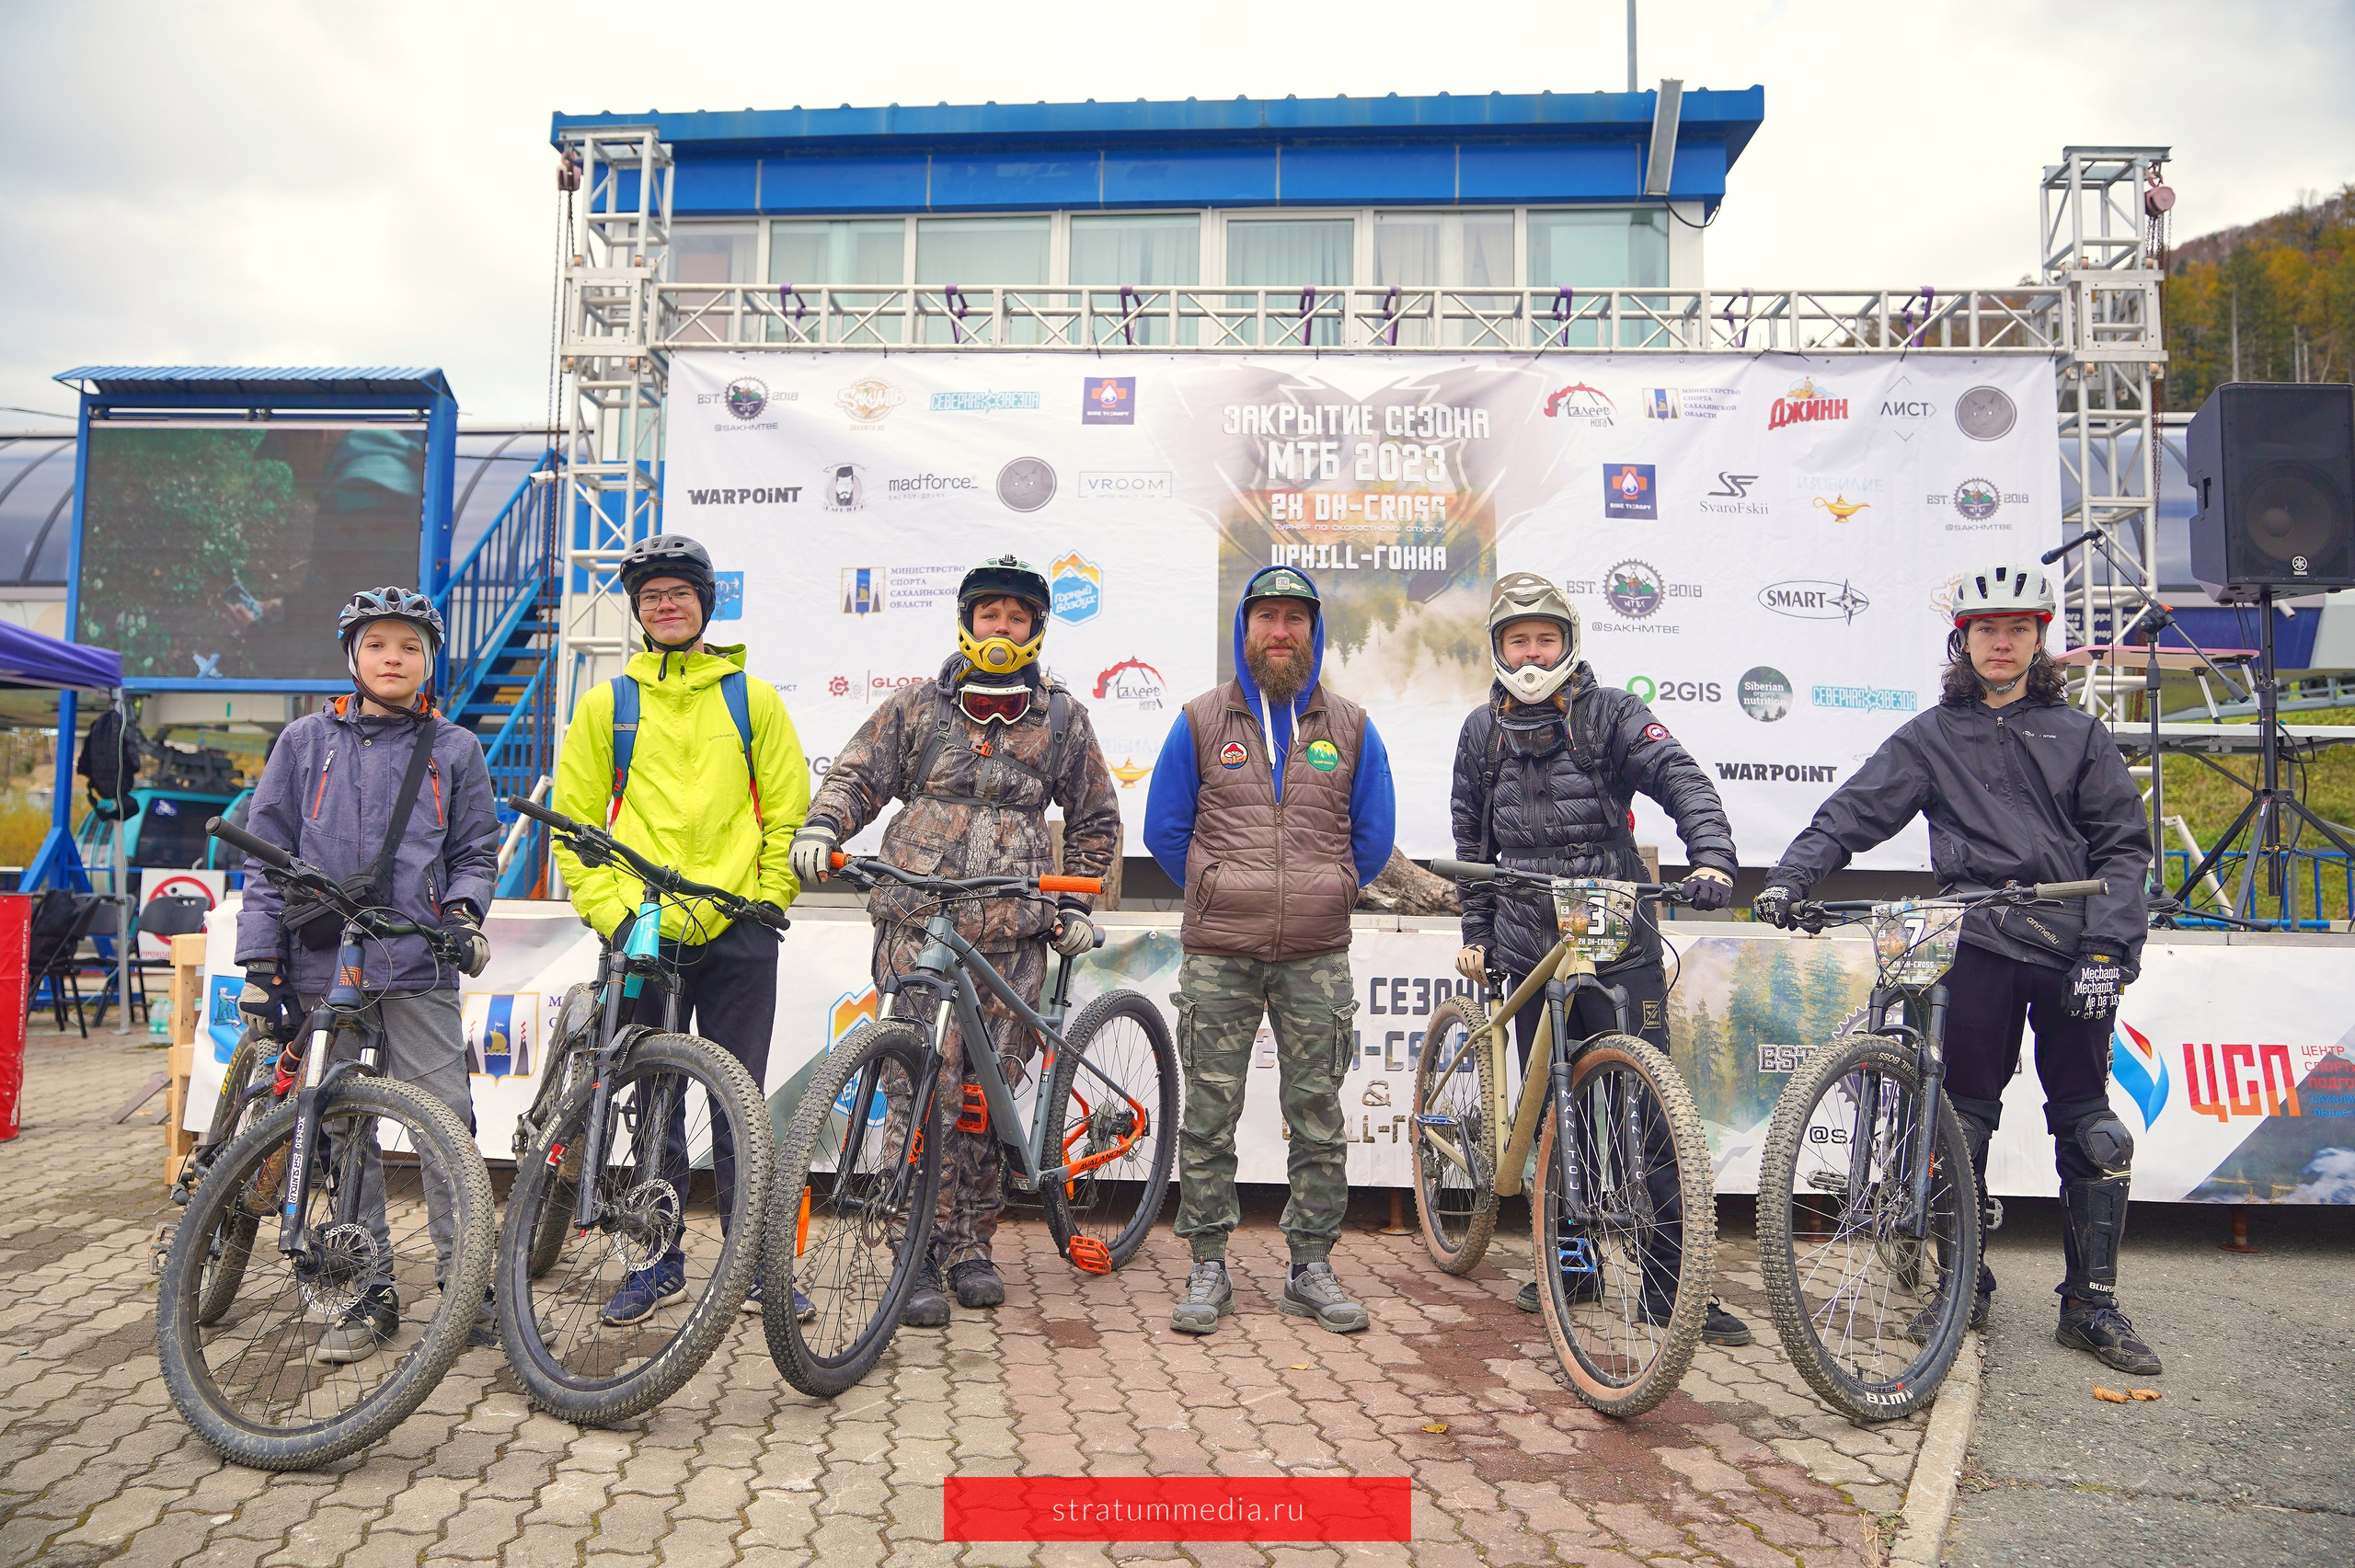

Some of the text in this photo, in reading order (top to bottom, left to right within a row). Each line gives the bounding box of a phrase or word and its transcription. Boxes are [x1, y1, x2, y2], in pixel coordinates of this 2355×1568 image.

[697, 391, 798, 405] EST. 2018
[1682, 387, 1740, 395] МИНИСТЕРСТВО
[930, 391, 1040, 411] СЕВЕРНАЯ ЗВЕЗДА
[1683, 403, 1738, 411] САХАЛИНСКОЙ
[1880, 401, 1929, 418] ЛИСТ
[714, 422, 779, 432] @SAKHMTBE
[1223, 405, 1491, 439] ЗАКРЫТИЕ СЕЗОНА
[1267, 441, 1446, 482] МТБ 2023
[1087, 477, 1165, 490] VROOM
[1926, 494, 2029, 505] EST. 2018
[1270, 493, 1446, 521] 2X DH-CROSS
[1700, 501, 1769, 515] SvaroFskii
[1273, 523, 1310, 532] ТУРНИР
[1331, 524, 1402, 533] СКОРОСТНОМУ
[1405, 525, 1444, 534] СПУСКУ
[1945, 523, 2013, 532] @SAKHMTBE
[890, 566, 966, 575] МИНИСТЕРСТВО
[890, 578, 927, 587] СПОРТА
[1566, 580, 1703, 598] EST. 2018
[890, 587, 959, 598] САХАЛИНСКОЙ
[1766, 589, 1827, 609] SMART
[890, 600, 933, 609] ОБЛАСТИ
[1591, 622, 1681, 635] @SAKHMTBE
[1659, 681, 1722, 703] 2GIS
[1743, 681, 1784, 692] Siberian
[1743, 695, 1786, 706] nutrition
[1753, 691, 1775, 699] organic
[1811, 685, 1918, 712] СЕВЕРНАЯ ЗВЕЗДА
[1587, 896, 1607, 936] 3
[2026, 916, 2061, 945] anmeilu
[1587, 938, 1614, 946] DH-CROSS
[1903, 918, 1925, 958] 7
[1878, 1051, 1901, 1065] BOSS
[2301, 1045, 2345, 1057] ЦЕНТР
[221, 1047, 243, 1096] MAXXIS
[2182, 1043, 2301, 1123] ЦСП
[2307, 1076, 2355, 1090] ПОДГО
[1361, 1080, 1391, 1106] &
[2311, 1094, 2355, 1104] САХАЛИ
[2314, 1108, 2355, 1117] ОБЛАСТ
[294, 1116, 306, 1150] XCM30
[1561, 1089, 1580, 1190] MANITOU
[1627, 1095, 1647, 1181] MANITO
[1078, 1147, 1128, 1172] AVALANCHE
[1865, 1391, 1907, 1405] WTB
